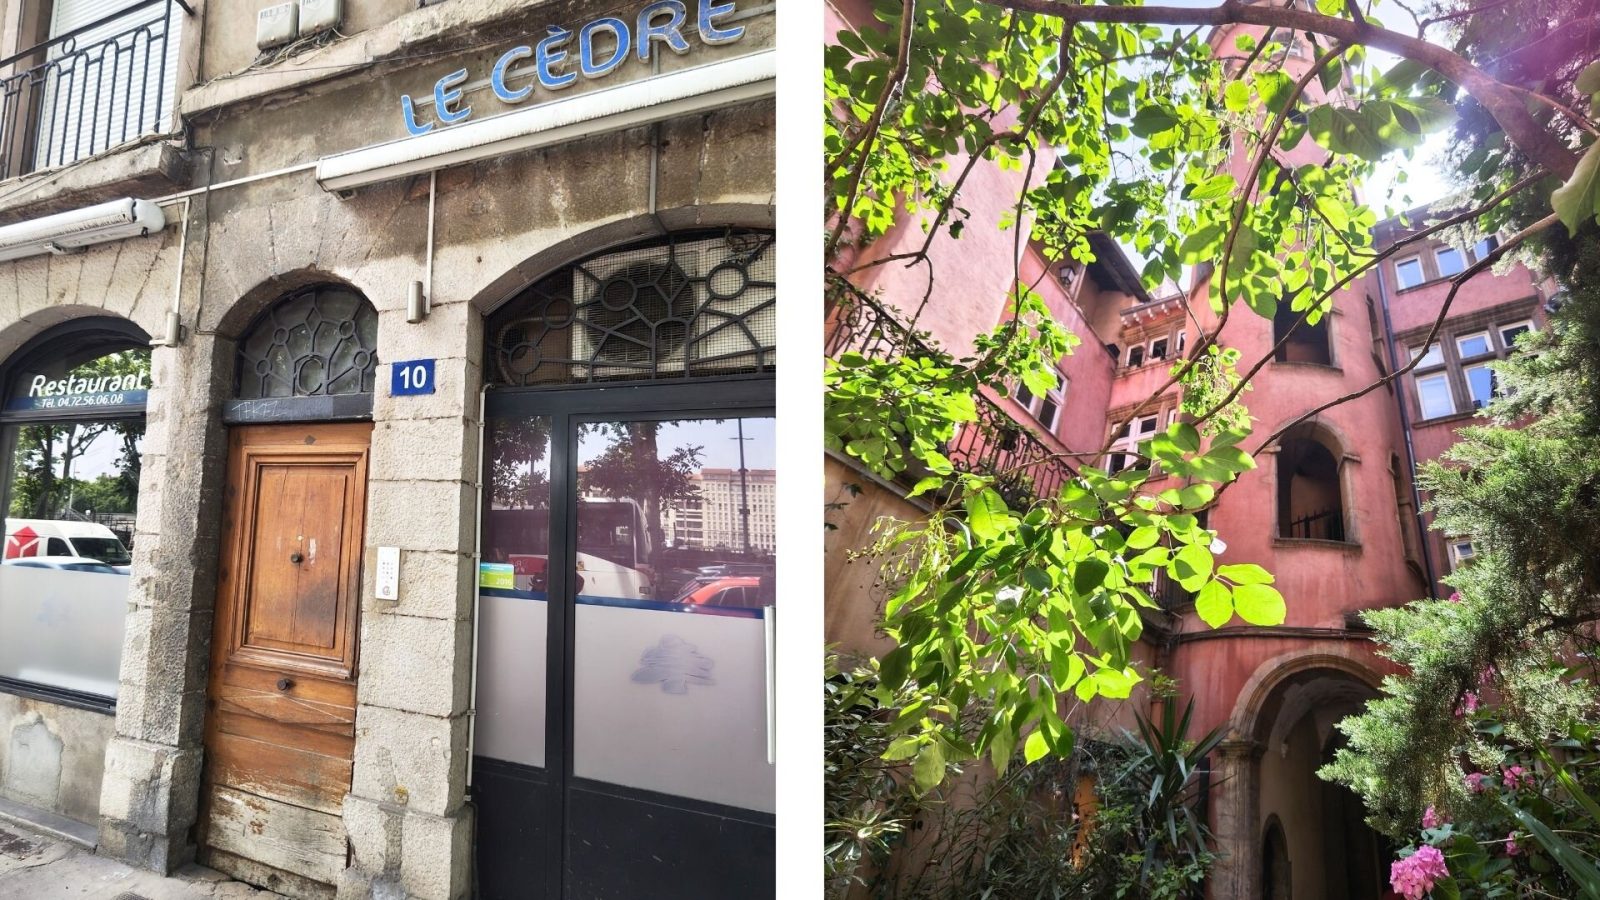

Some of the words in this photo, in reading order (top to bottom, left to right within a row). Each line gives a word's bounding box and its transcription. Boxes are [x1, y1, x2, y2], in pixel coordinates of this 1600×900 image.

[401, 67, 473, 136] LE
[490, 0, 747, 104] CÈDRE
[29, 369, 147, 397] Restaurant
[399, 365, 427, 389] 10
[57, 394, 124, 407] 04.72.56.06.08
